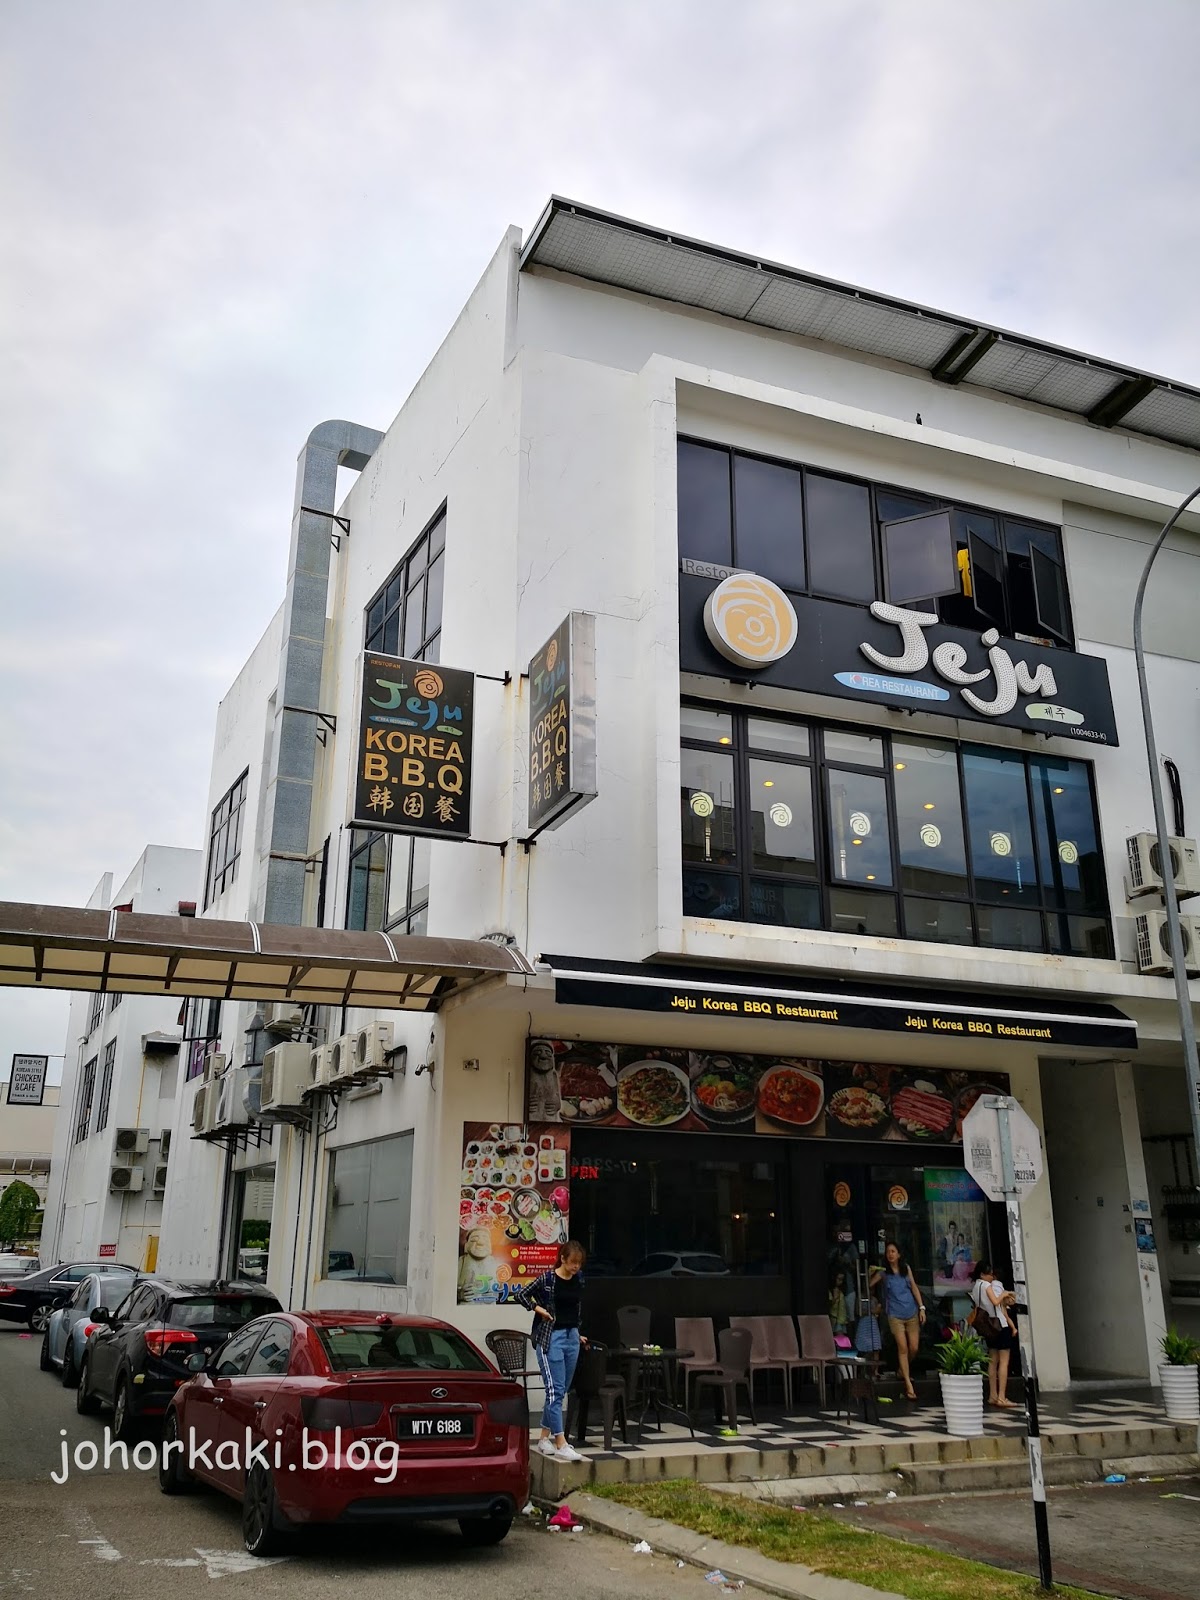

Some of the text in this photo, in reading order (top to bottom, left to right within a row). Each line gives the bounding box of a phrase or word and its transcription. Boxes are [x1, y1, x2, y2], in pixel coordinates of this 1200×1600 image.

[859, 601, 1058, 717] Jeju
[881, 677, 940, 700] RESTAURANT
[369, 678, 463, 731] Jeju
[1044, 705, 1066, 719] 제주
[531, 699, 568, 748] KOREA
[365, 728, 465, 764] KOREA
[531, 725, 567, 783] B.B.Q
[364, 752, 463, 796] B.B.Q
[670, 995, 839, 1020] Jeju Korea BBQ Restaurant
[905, 1015, 1052, 1038] Jeju Korea BBQ Restaurant
[14, 1073, 42, 1083] CHICKEN
[412, 1419, 461, 1435] WTY 6188
